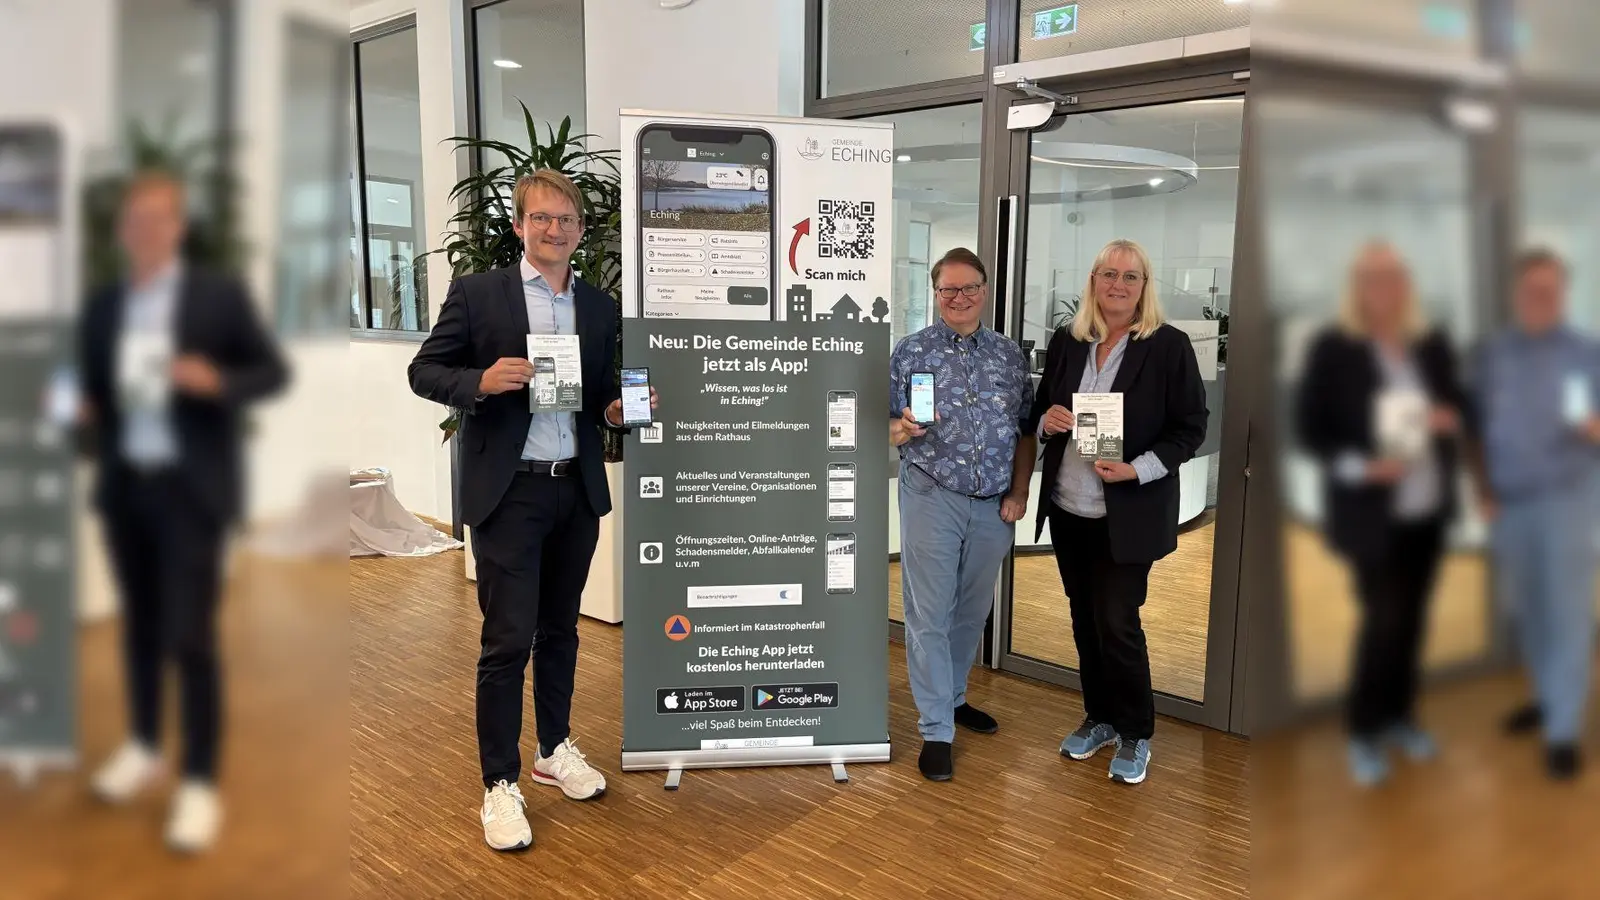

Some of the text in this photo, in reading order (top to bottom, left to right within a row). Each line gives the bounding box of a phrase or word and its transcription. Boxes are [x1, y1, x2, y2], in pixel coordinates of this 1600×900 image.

[832, 148, 892, 164] ECHING
[650, 210, 680, 221] Eching
[805, 268, 866, 281] Scan mich
[649, 334, 864, 354] Neu: Die Gemeinde Eching
[702, 356, 808, 374] jetzt als App!
[742, 385, 760, 393] was
[762, 384, 775, 393] los
[776, 384, 788, 393] ist
[720, 396, 730, 405] in
[676, 421, 810, 432] Neuigkeiten und Eilmeldungen
[693, 432, 713, 442] dem
[715, 432, 751, 442] Rathaus
[676, 470, 810, 482] Aktuelles und Veranstaltungen
[676, 482, 817, 493] unserer Vereine, Organisationen
[676, 494, 757, 505] und Einrichtungen
[675, 534, 817, 546] Öffnungszeiten, Online-Anträge,
[675, 546, 815, 557] Schadensmelder, Abfallkalender
[694, 621, 825, 633] Informiert im Katastrophenfall
[698, 644, 814, 658] Die Eching App jetzt
[686, 659, 825, 673] kostenlos herunterladen
[684, 698, 738, 711] App Store
[778, 694, 833, 706] Google Play
[682, 716, 821, 731] ...viel Spaß beim Entdecken!
